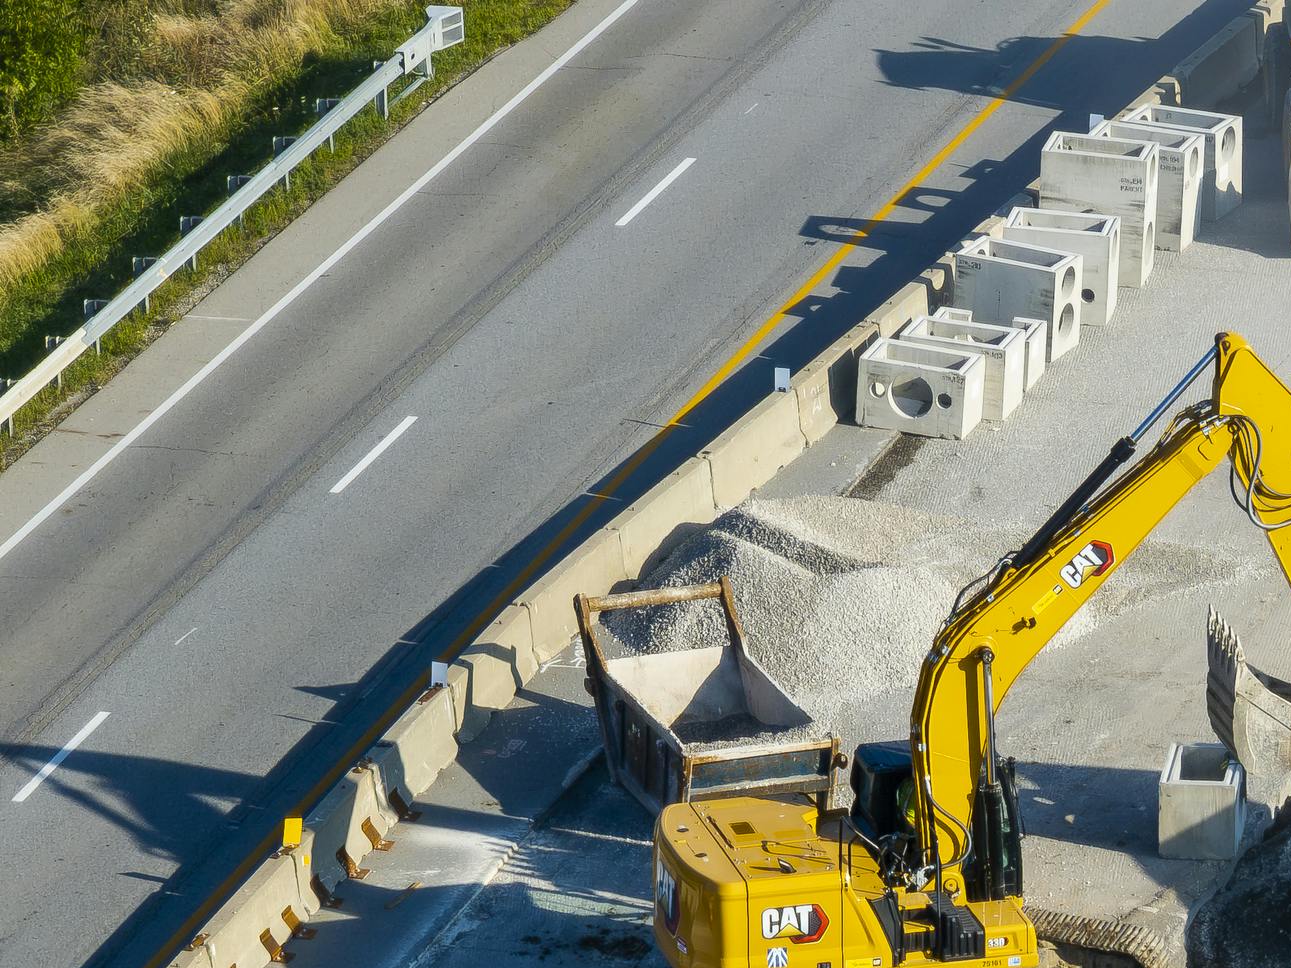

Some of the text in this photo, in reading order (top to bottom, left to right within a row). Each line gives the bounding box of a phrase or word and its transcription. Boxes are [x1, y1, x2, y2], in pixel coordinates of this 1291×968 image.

[1060, 543, 1104, 589] CAT
[656, 860, 676, 919] CAT
[762, 904, 813, 939] CAT
